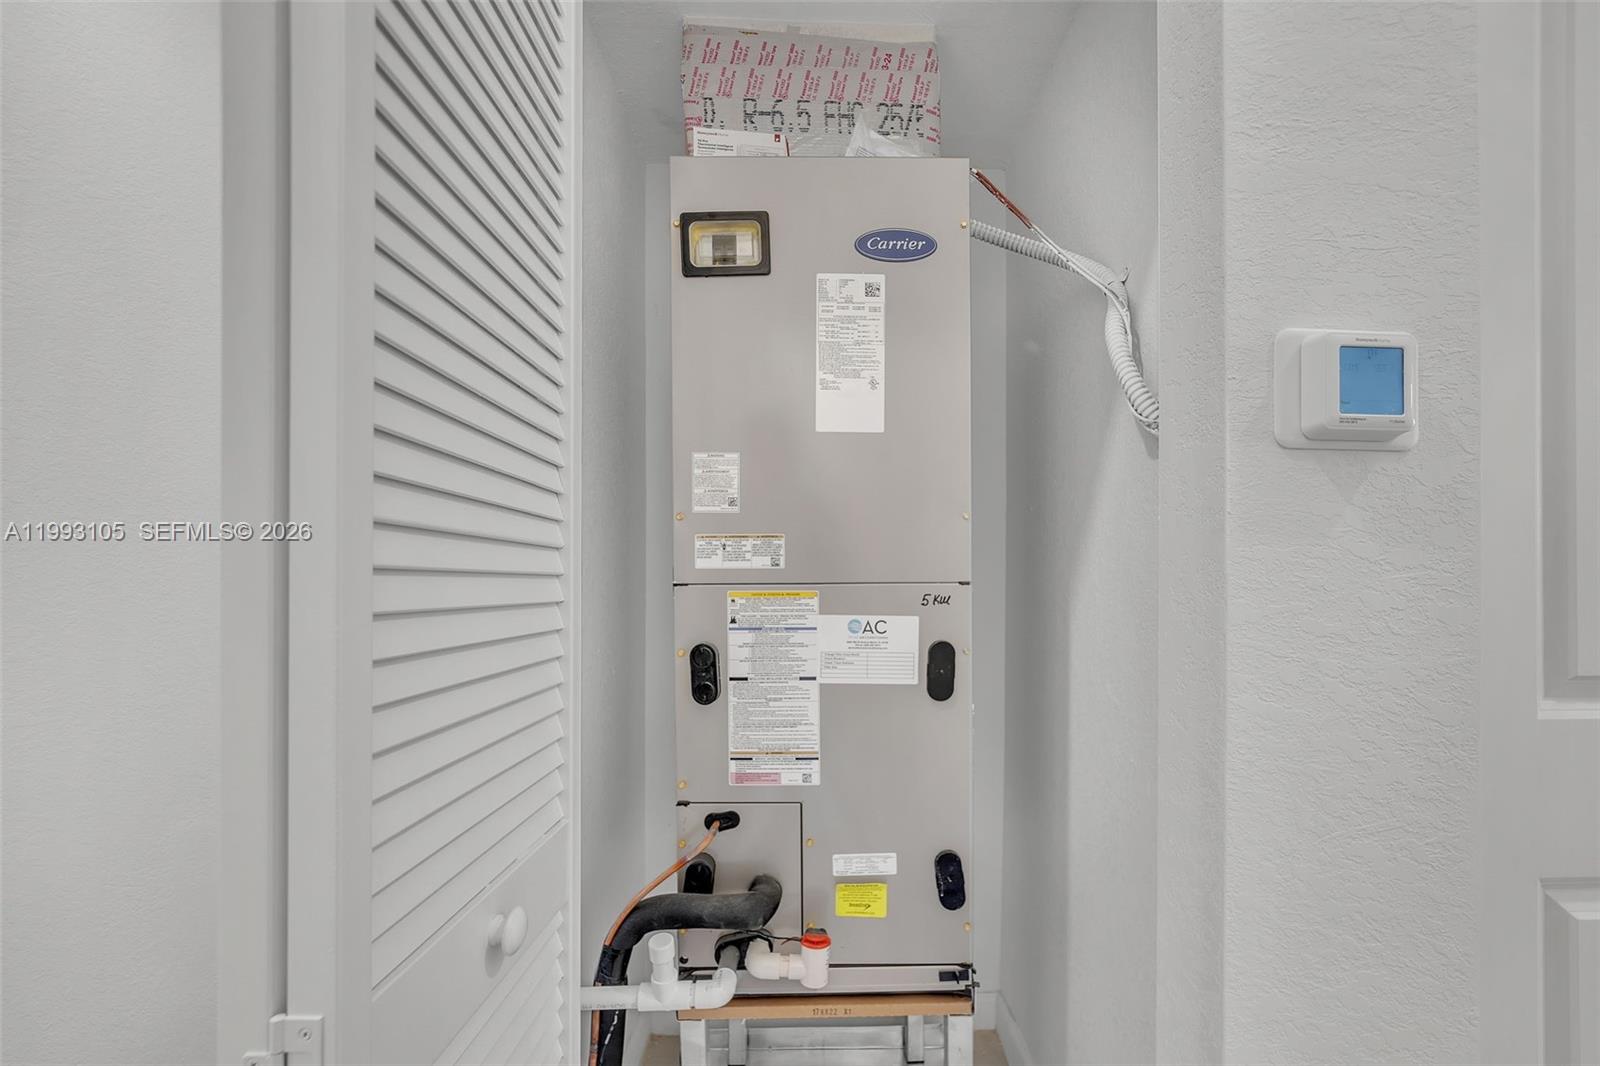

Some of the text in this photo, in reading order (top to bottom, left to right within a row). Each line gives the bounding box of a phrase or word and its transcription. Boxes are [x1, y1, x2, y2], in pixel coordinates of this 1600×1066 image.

[743, 98, 812, 132] R-6.5
[866, 236, 927, 250] Carrier
[921, 593, 932, 607] 5
[862, 619, 888, 635] AC
